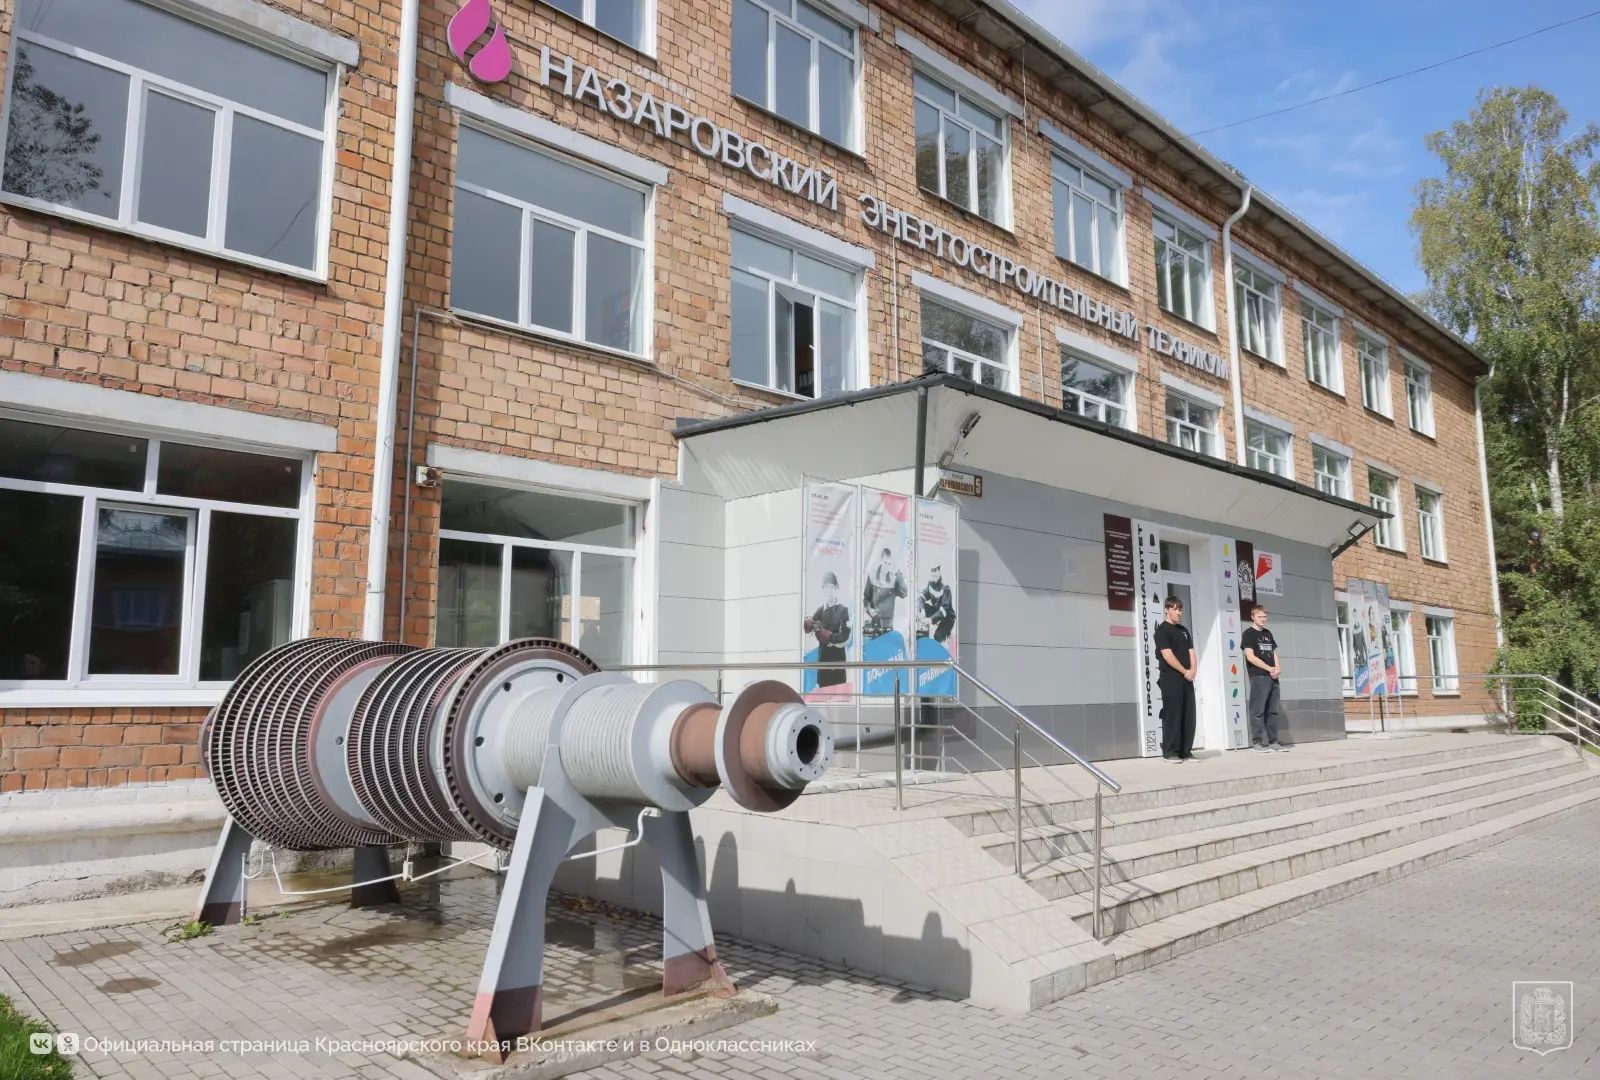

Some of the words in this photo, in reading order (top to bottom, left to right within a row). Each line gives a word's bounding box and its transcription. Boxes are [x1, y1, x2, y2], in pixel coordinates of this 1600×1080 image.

[540, 45, 838, 211] НАЗАРОВСКИЙ
[857, 193, 1140, 342] ЭНЕРГОСТРОИТЕЛЬНЫЙ
[1146, 324, 1229, 380] ТЕХНИКУМ
[975, 477, 981, 495] 5
[1137, 523, 1153, 717] ПРОФЕССИОНАЛИТЕТ
[1147, 730, 1157, 752] 2023
